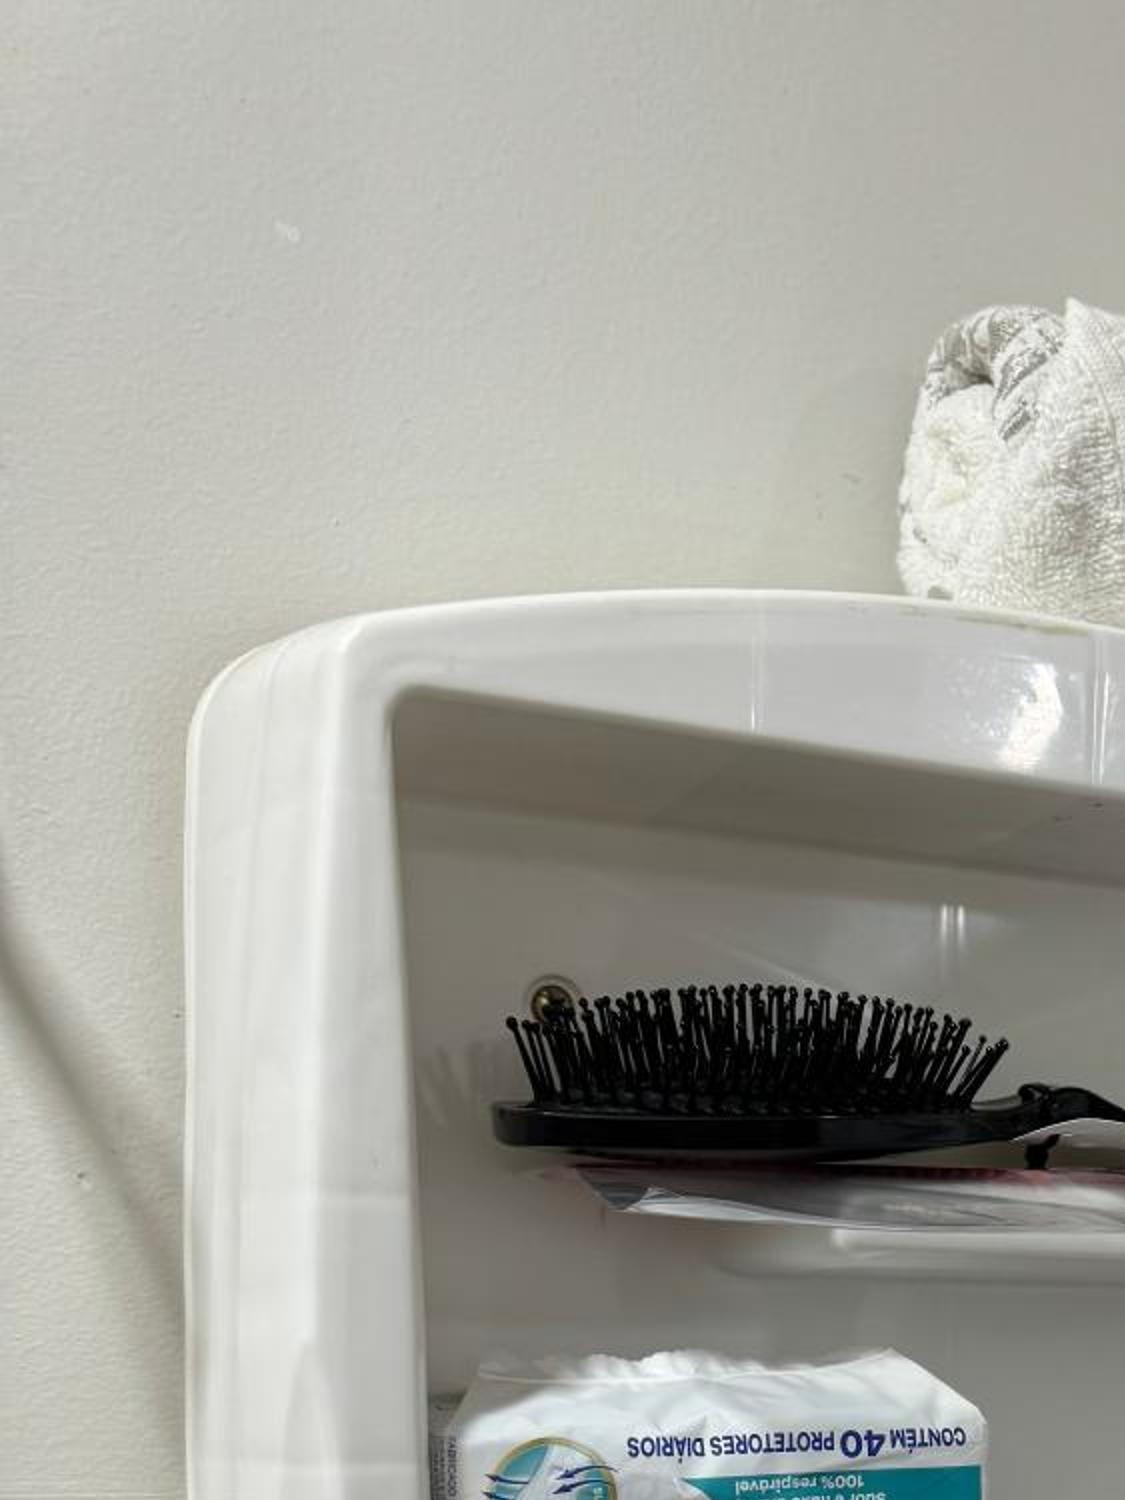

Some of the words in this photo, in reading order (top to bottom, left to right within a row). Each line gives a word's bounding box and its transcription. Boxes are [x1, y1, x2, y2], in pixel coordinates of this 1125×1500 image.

[627, 1436, 705, 1462] DIÁRIOS
[710, 1432, 834, 1456] PROTETORES
[840, 1428, 886, 1458] 40
[890, 1427, 966, 1453] CONTÉM
[735, 1475, 818, 1495] respirável
[820, 1474, 864, 1491] 100%
